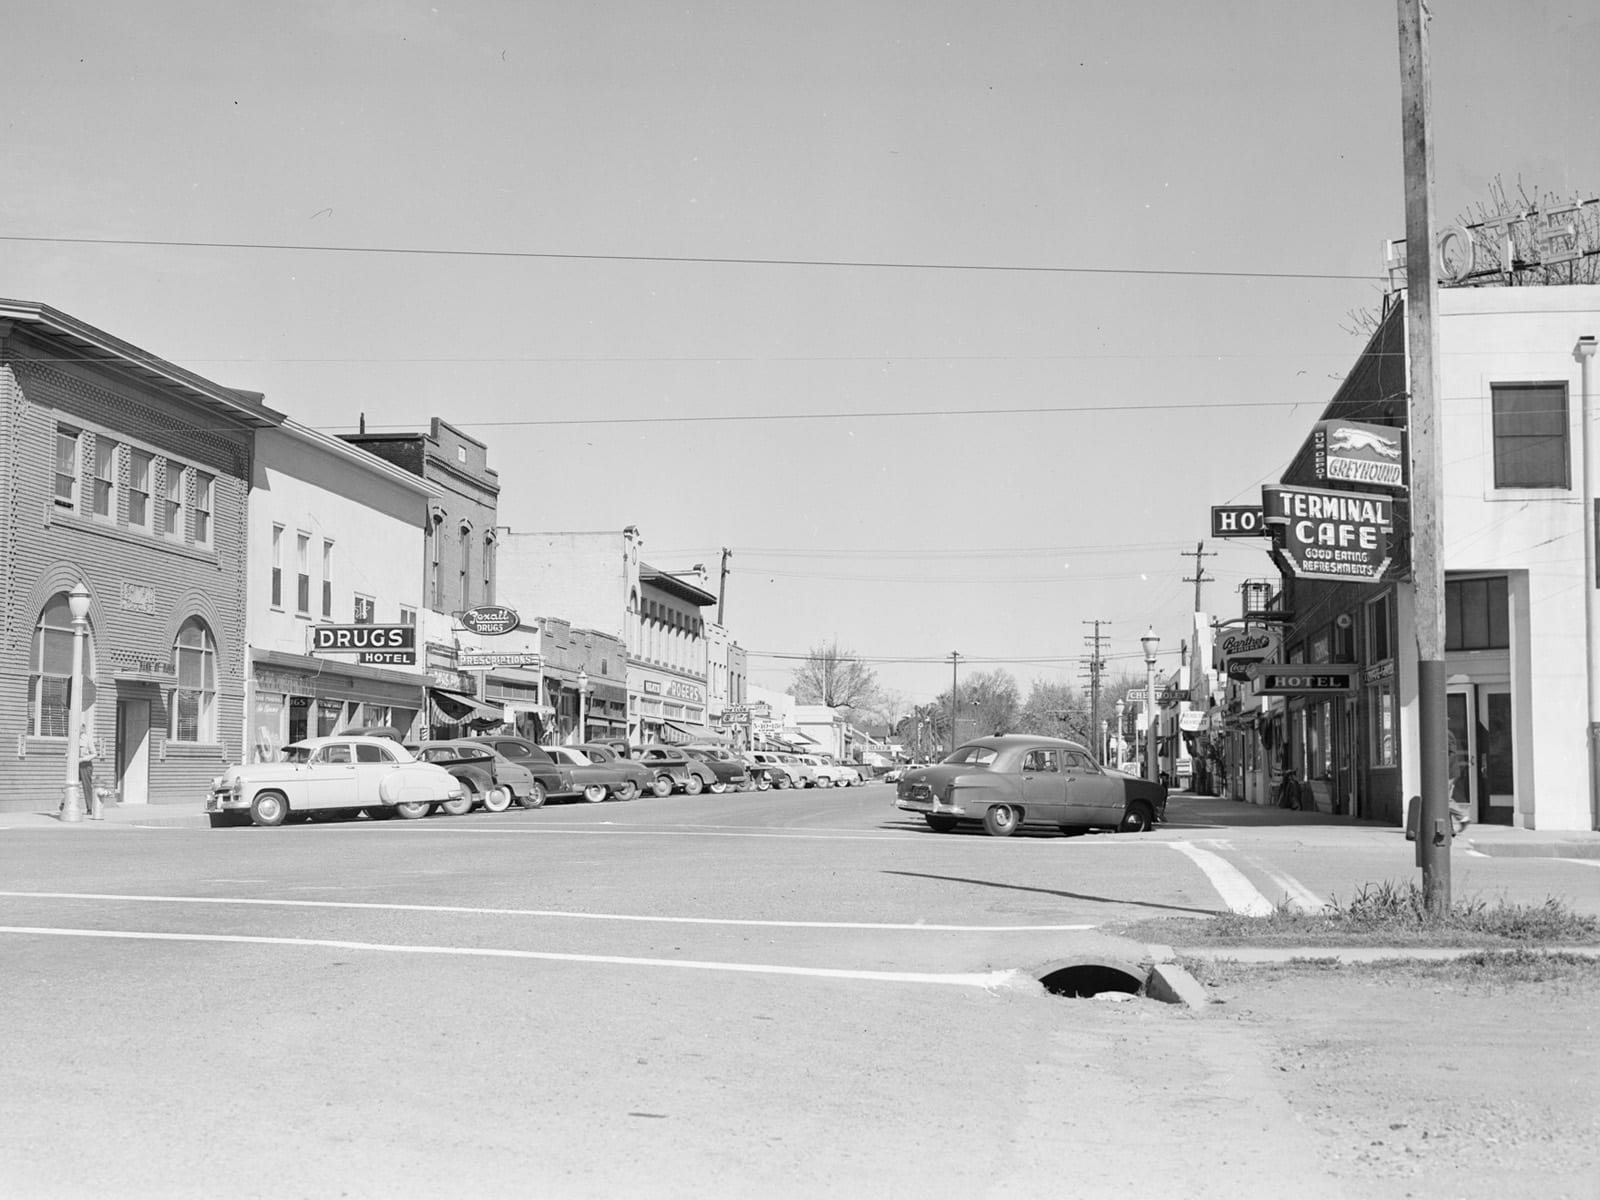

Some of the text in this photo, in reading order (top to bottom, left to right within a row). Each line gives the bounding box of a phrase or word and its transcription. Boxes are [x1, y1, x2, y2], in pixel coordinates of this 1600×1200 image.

[1329, 458, 1400, 483] GREYHOUND
[1279, 492, 1390, 524] TERMINAL
[1295, 520, 1378, 550] CAFE
[1305, 547, 1368, 563] GOOD EATING
[1302, 560, 1373, 576] REFRESHMENTS
[469, 610, 510, 625] Rexall
[476, 624, 503, 633] DRUGS
[319, 629, 403, 647] DRUGS
[365, 653, 411, 663] HOTEL
[460, 655, 532, 665] PRESCRIPTIONS
[1274, 676, 1342, 688] HOTEL
[671, 681, 699, 701] ROGERS
